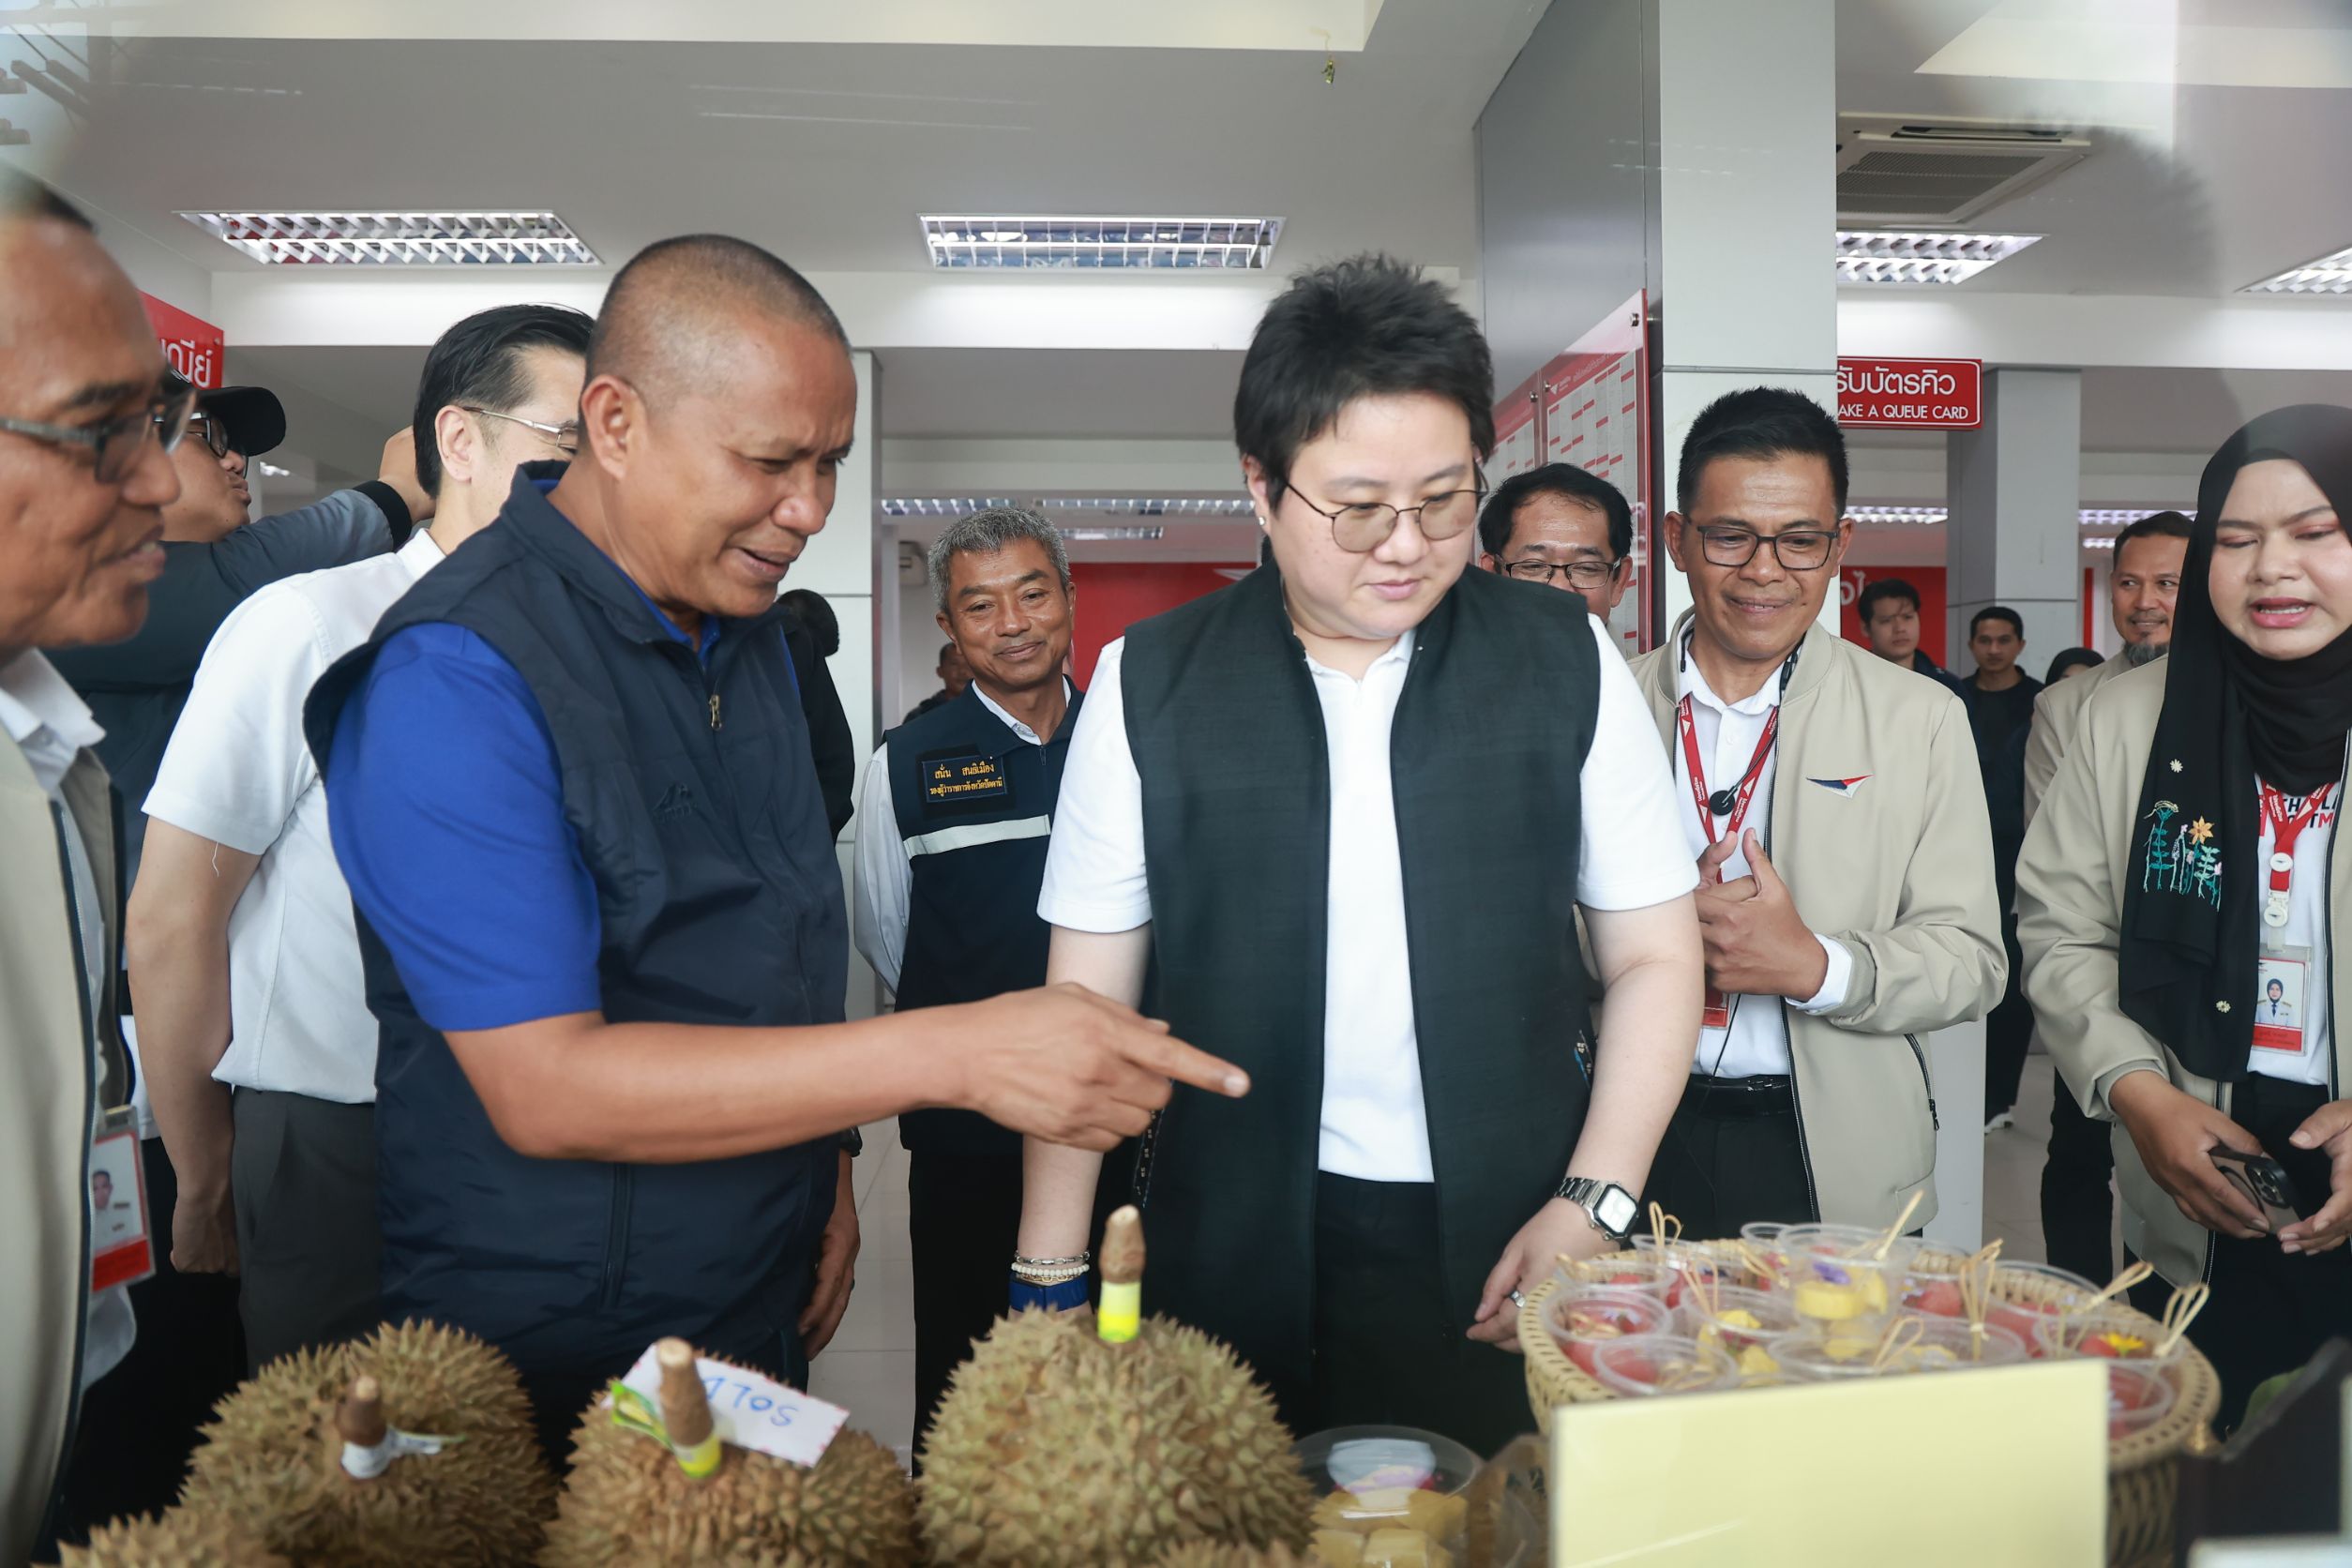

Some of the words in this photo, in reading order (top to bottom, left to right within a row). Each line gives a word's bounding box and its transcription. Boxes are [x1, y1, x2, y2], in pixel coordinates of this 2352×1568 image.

[1838, 403, 1863, 417] AKE
[1867, 404, 1879, 417] A
[1882, 404, 1928, 419] QUEUE
[1932, 405, 1969, 419] CARD
